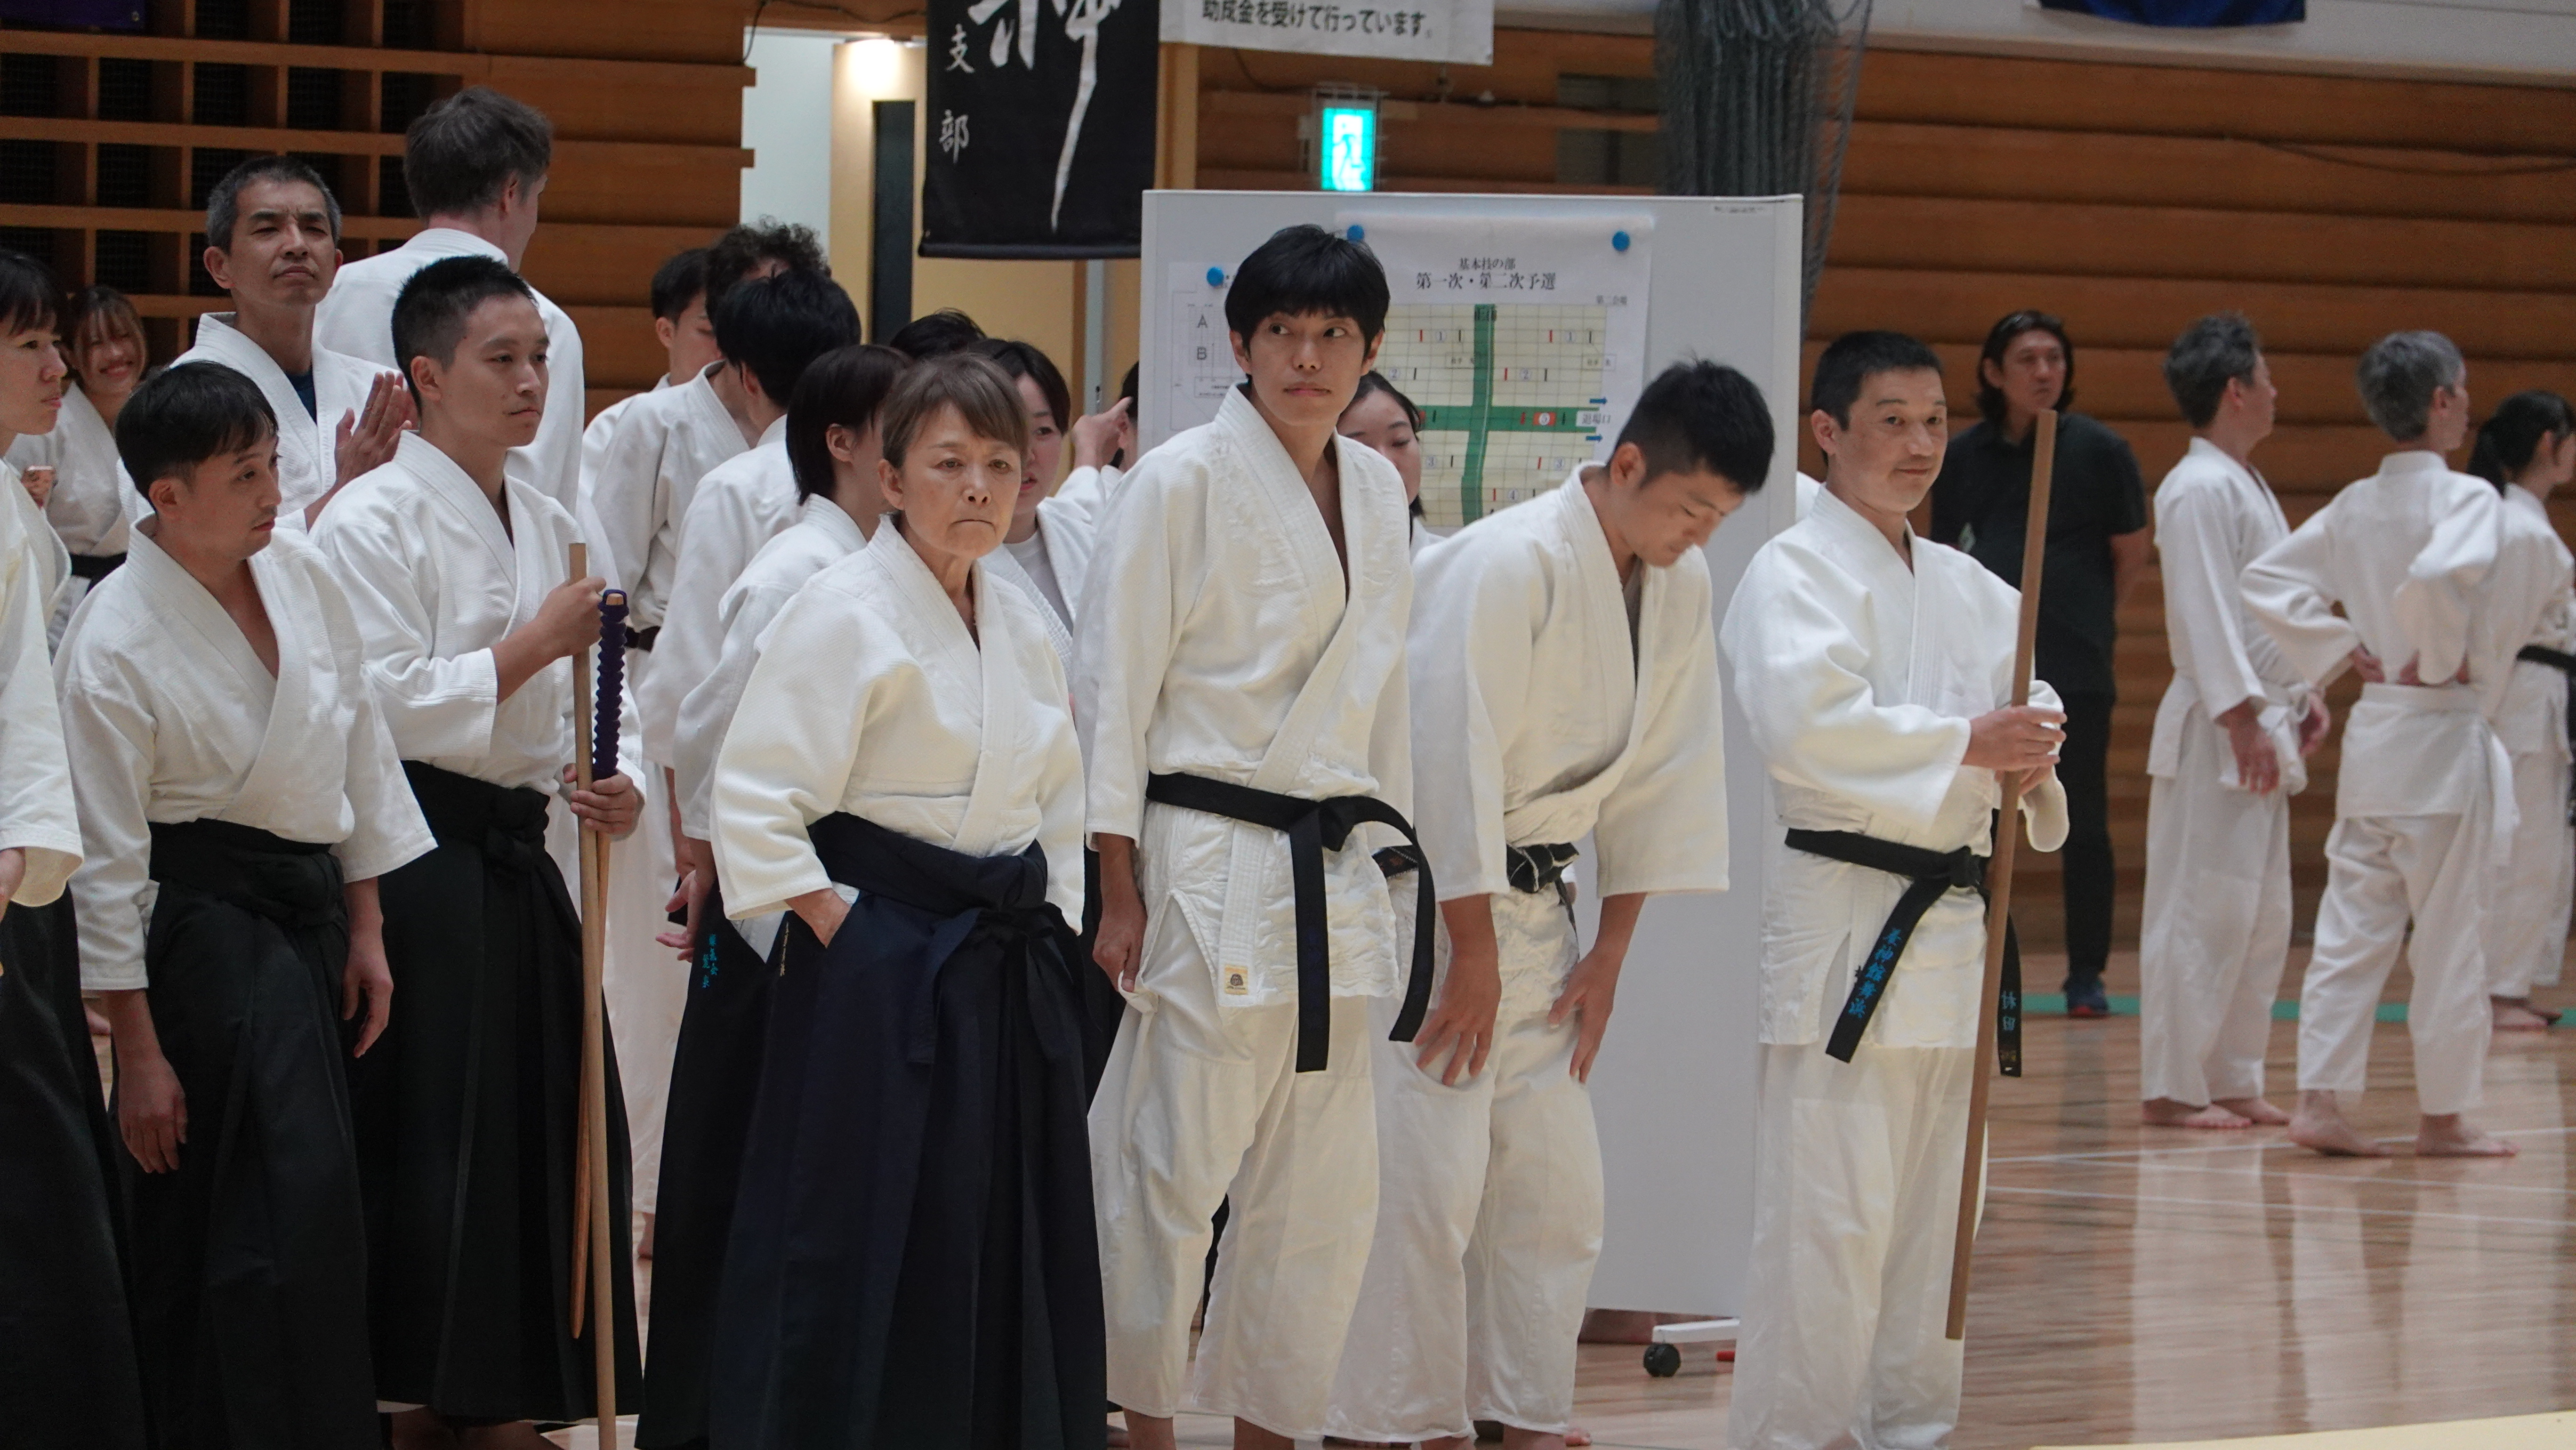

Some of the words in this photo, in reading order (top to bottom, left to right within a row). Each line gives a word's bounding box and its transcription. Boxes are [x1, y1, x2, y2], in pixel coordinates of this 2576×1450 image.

[1460, 257, 1516, 270] 基本技の部
[1417, 272, 1556, 290] 第一次・第二次予選
[1197, 314, 1208, 328] A
[1196, 346, 1207, 361] B
